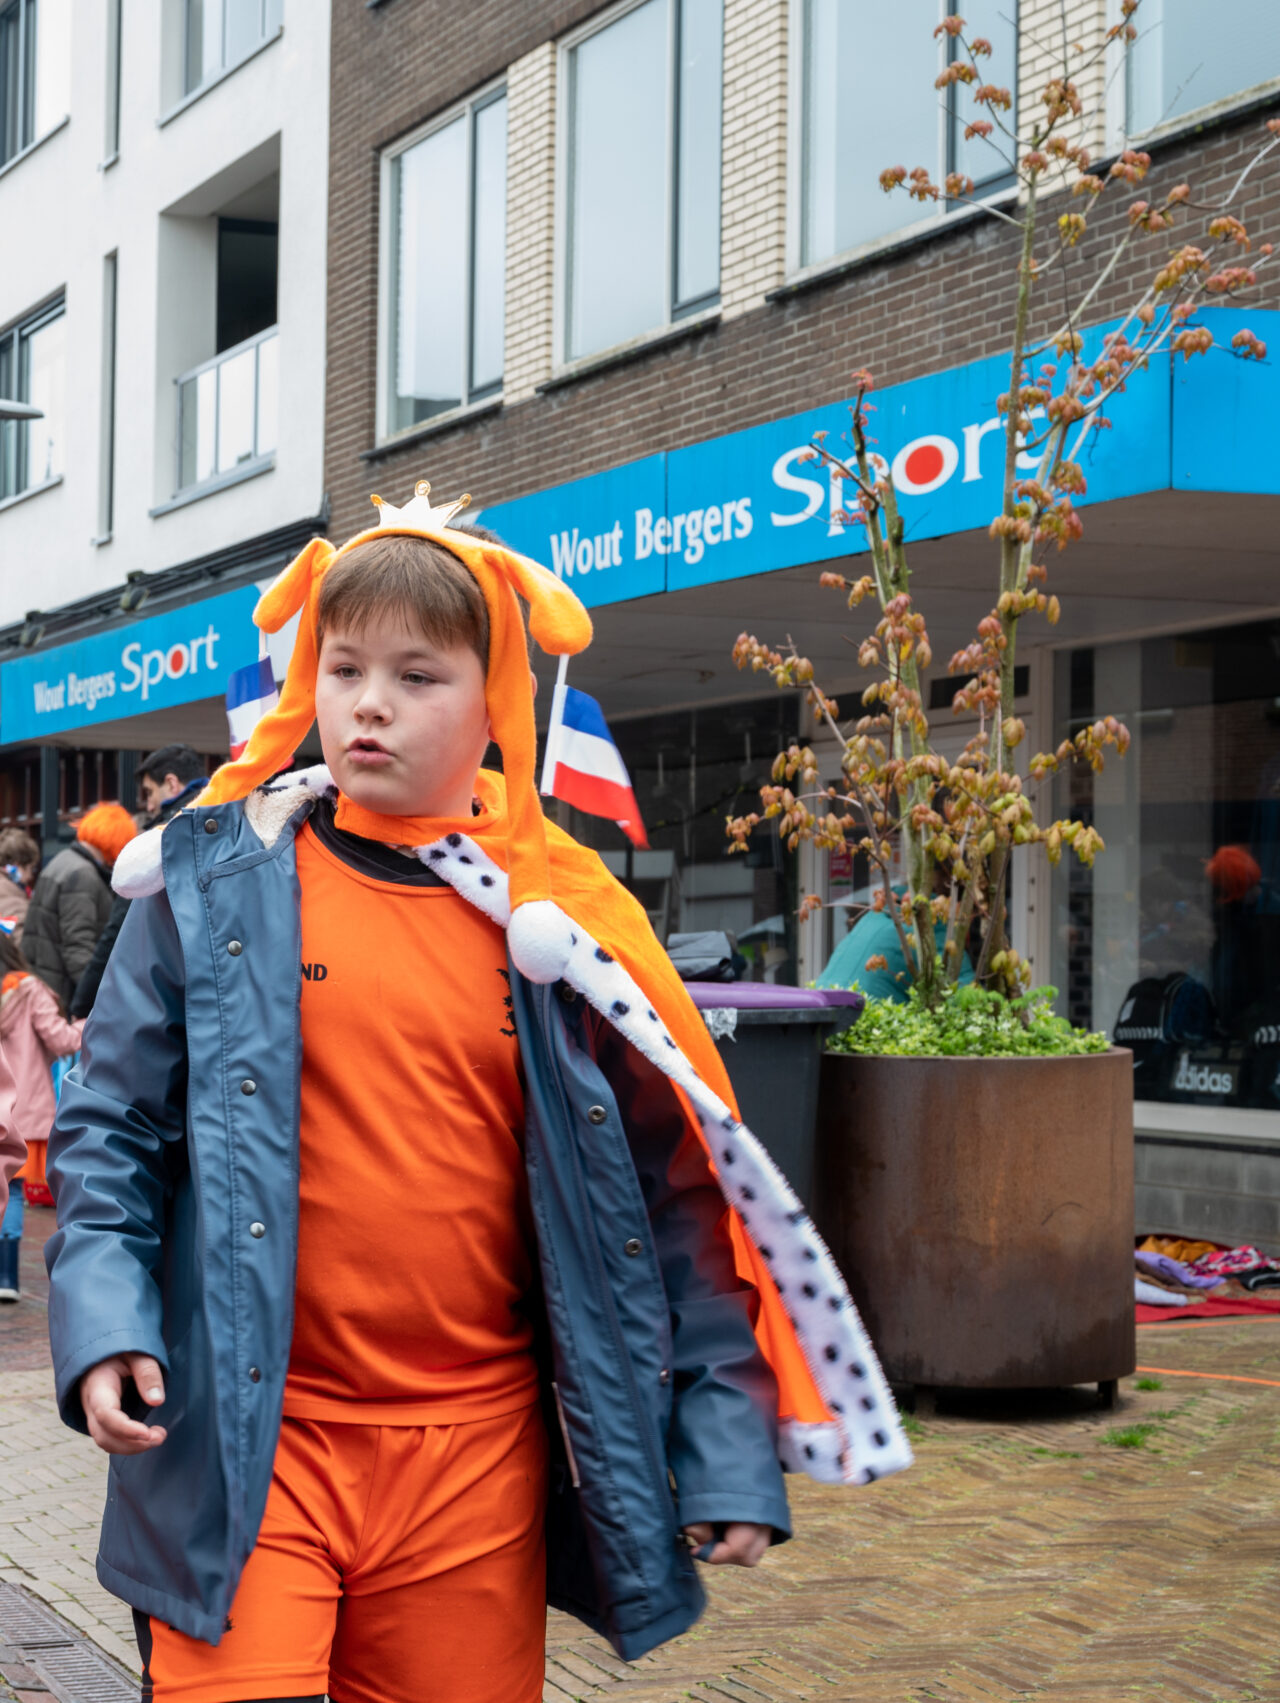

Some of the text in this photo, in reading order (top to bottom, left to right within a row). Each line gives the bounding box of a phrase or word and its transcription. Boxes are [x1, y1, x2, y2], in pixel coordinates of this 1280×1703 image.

[549, 519, 623, 579] Wout
[634, 497, 754, 564] Bergers
[33, 624, 220, 714] Wout Bergers Sport
